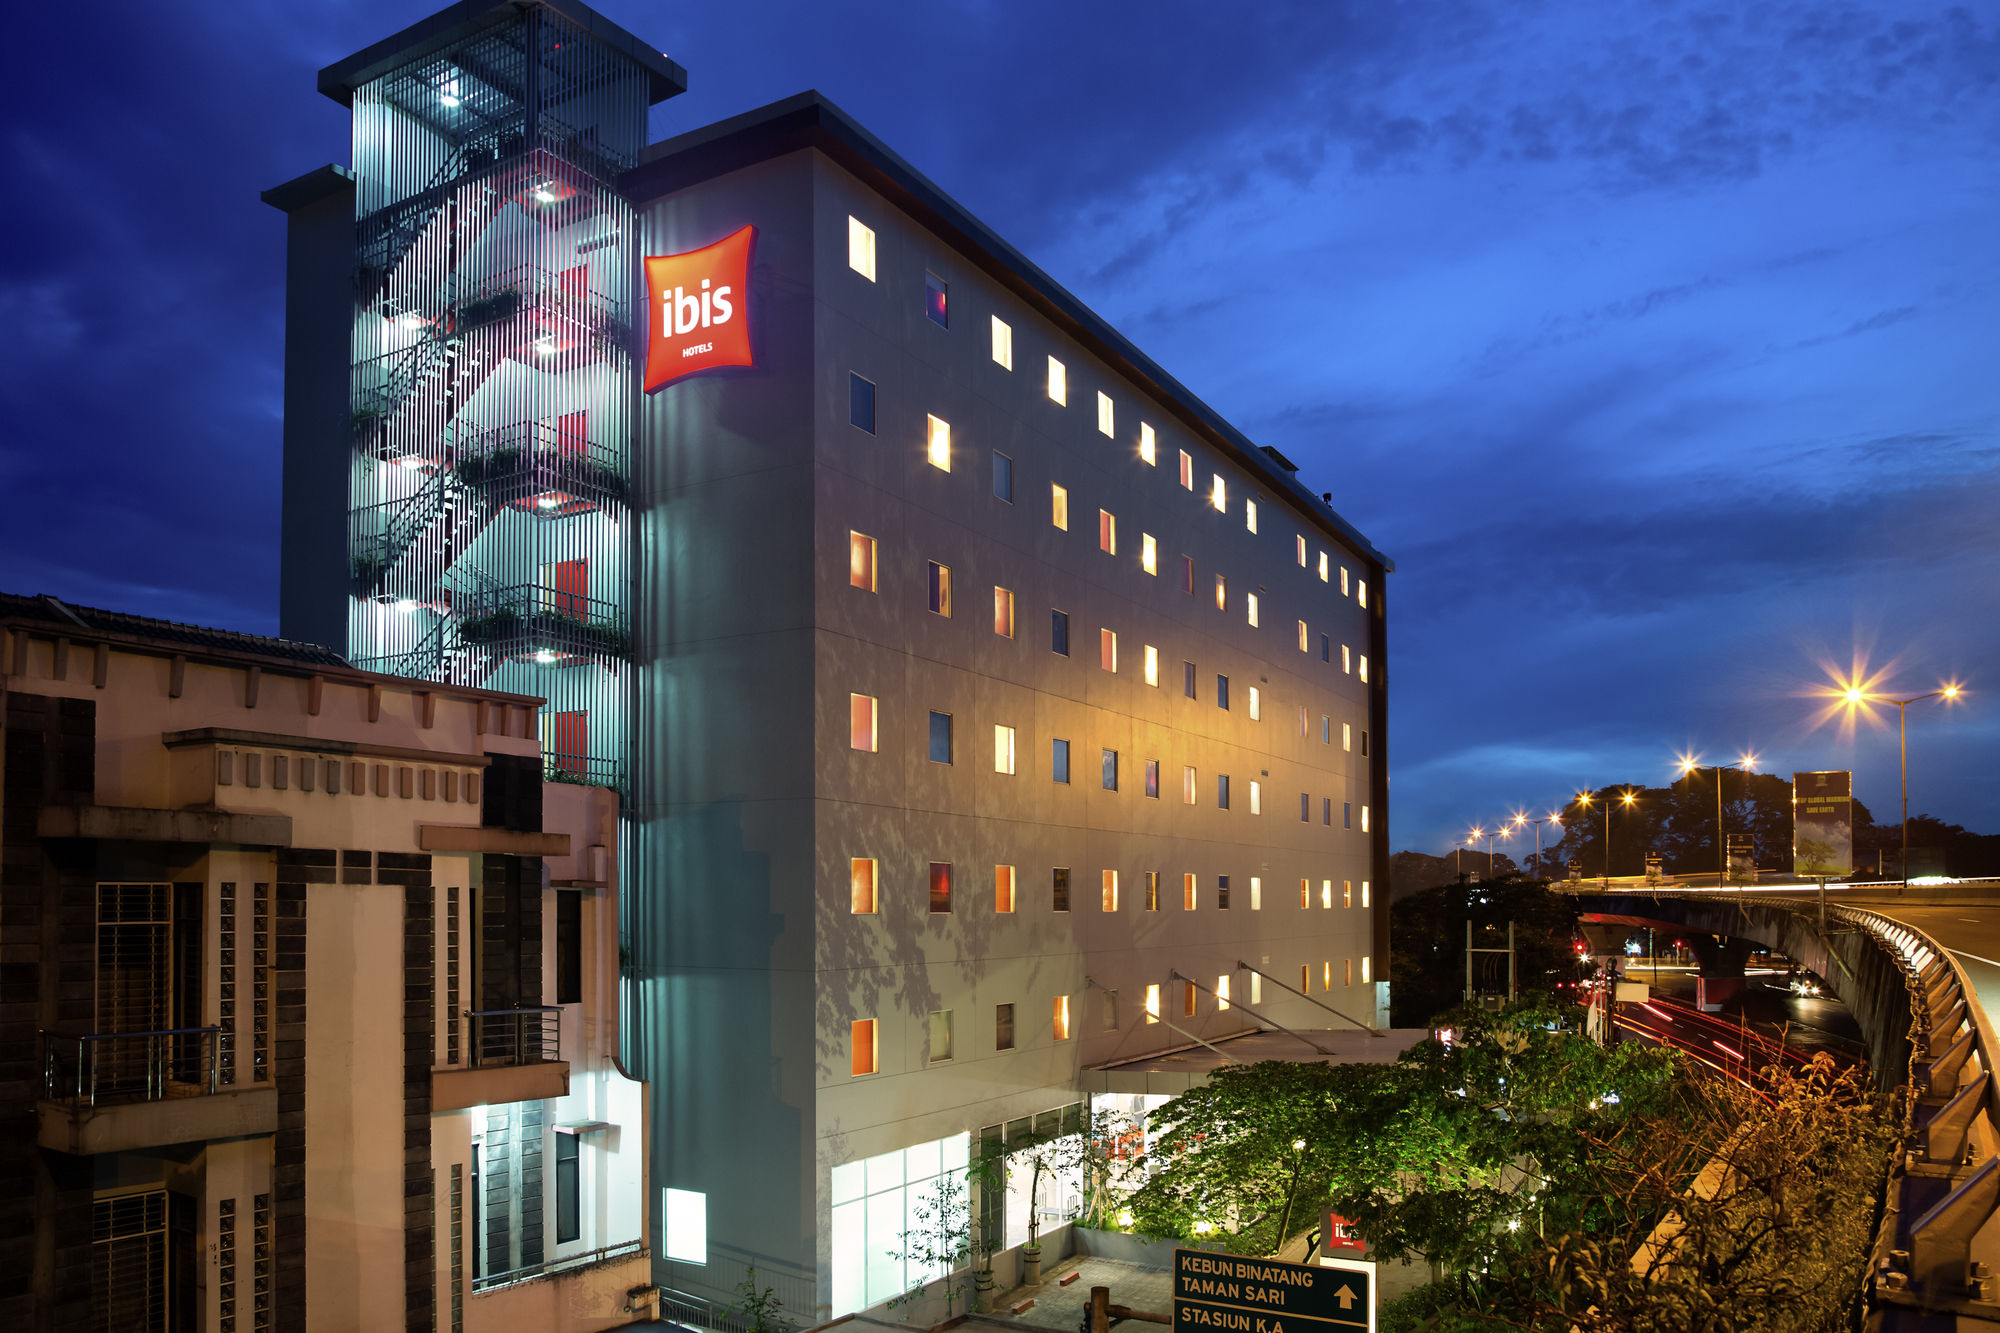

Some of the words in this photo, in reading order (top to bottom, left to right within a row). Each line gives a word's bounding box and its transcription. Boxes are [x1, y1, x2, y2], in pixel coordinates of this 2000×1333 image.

[663, 278, 732, 338] ibis
[682, 342, 713, 358] HOTELS
[1181, 1256, 1233, 1277] KEBUN
[1236, 1264, 1314, 1288] BINATANG
[1182, 1277, 1239, 1299] TAMAN
[1245, 1285, 1285, 1305] SARI
[1181, 1307, 1250, 1331] STASIUN
